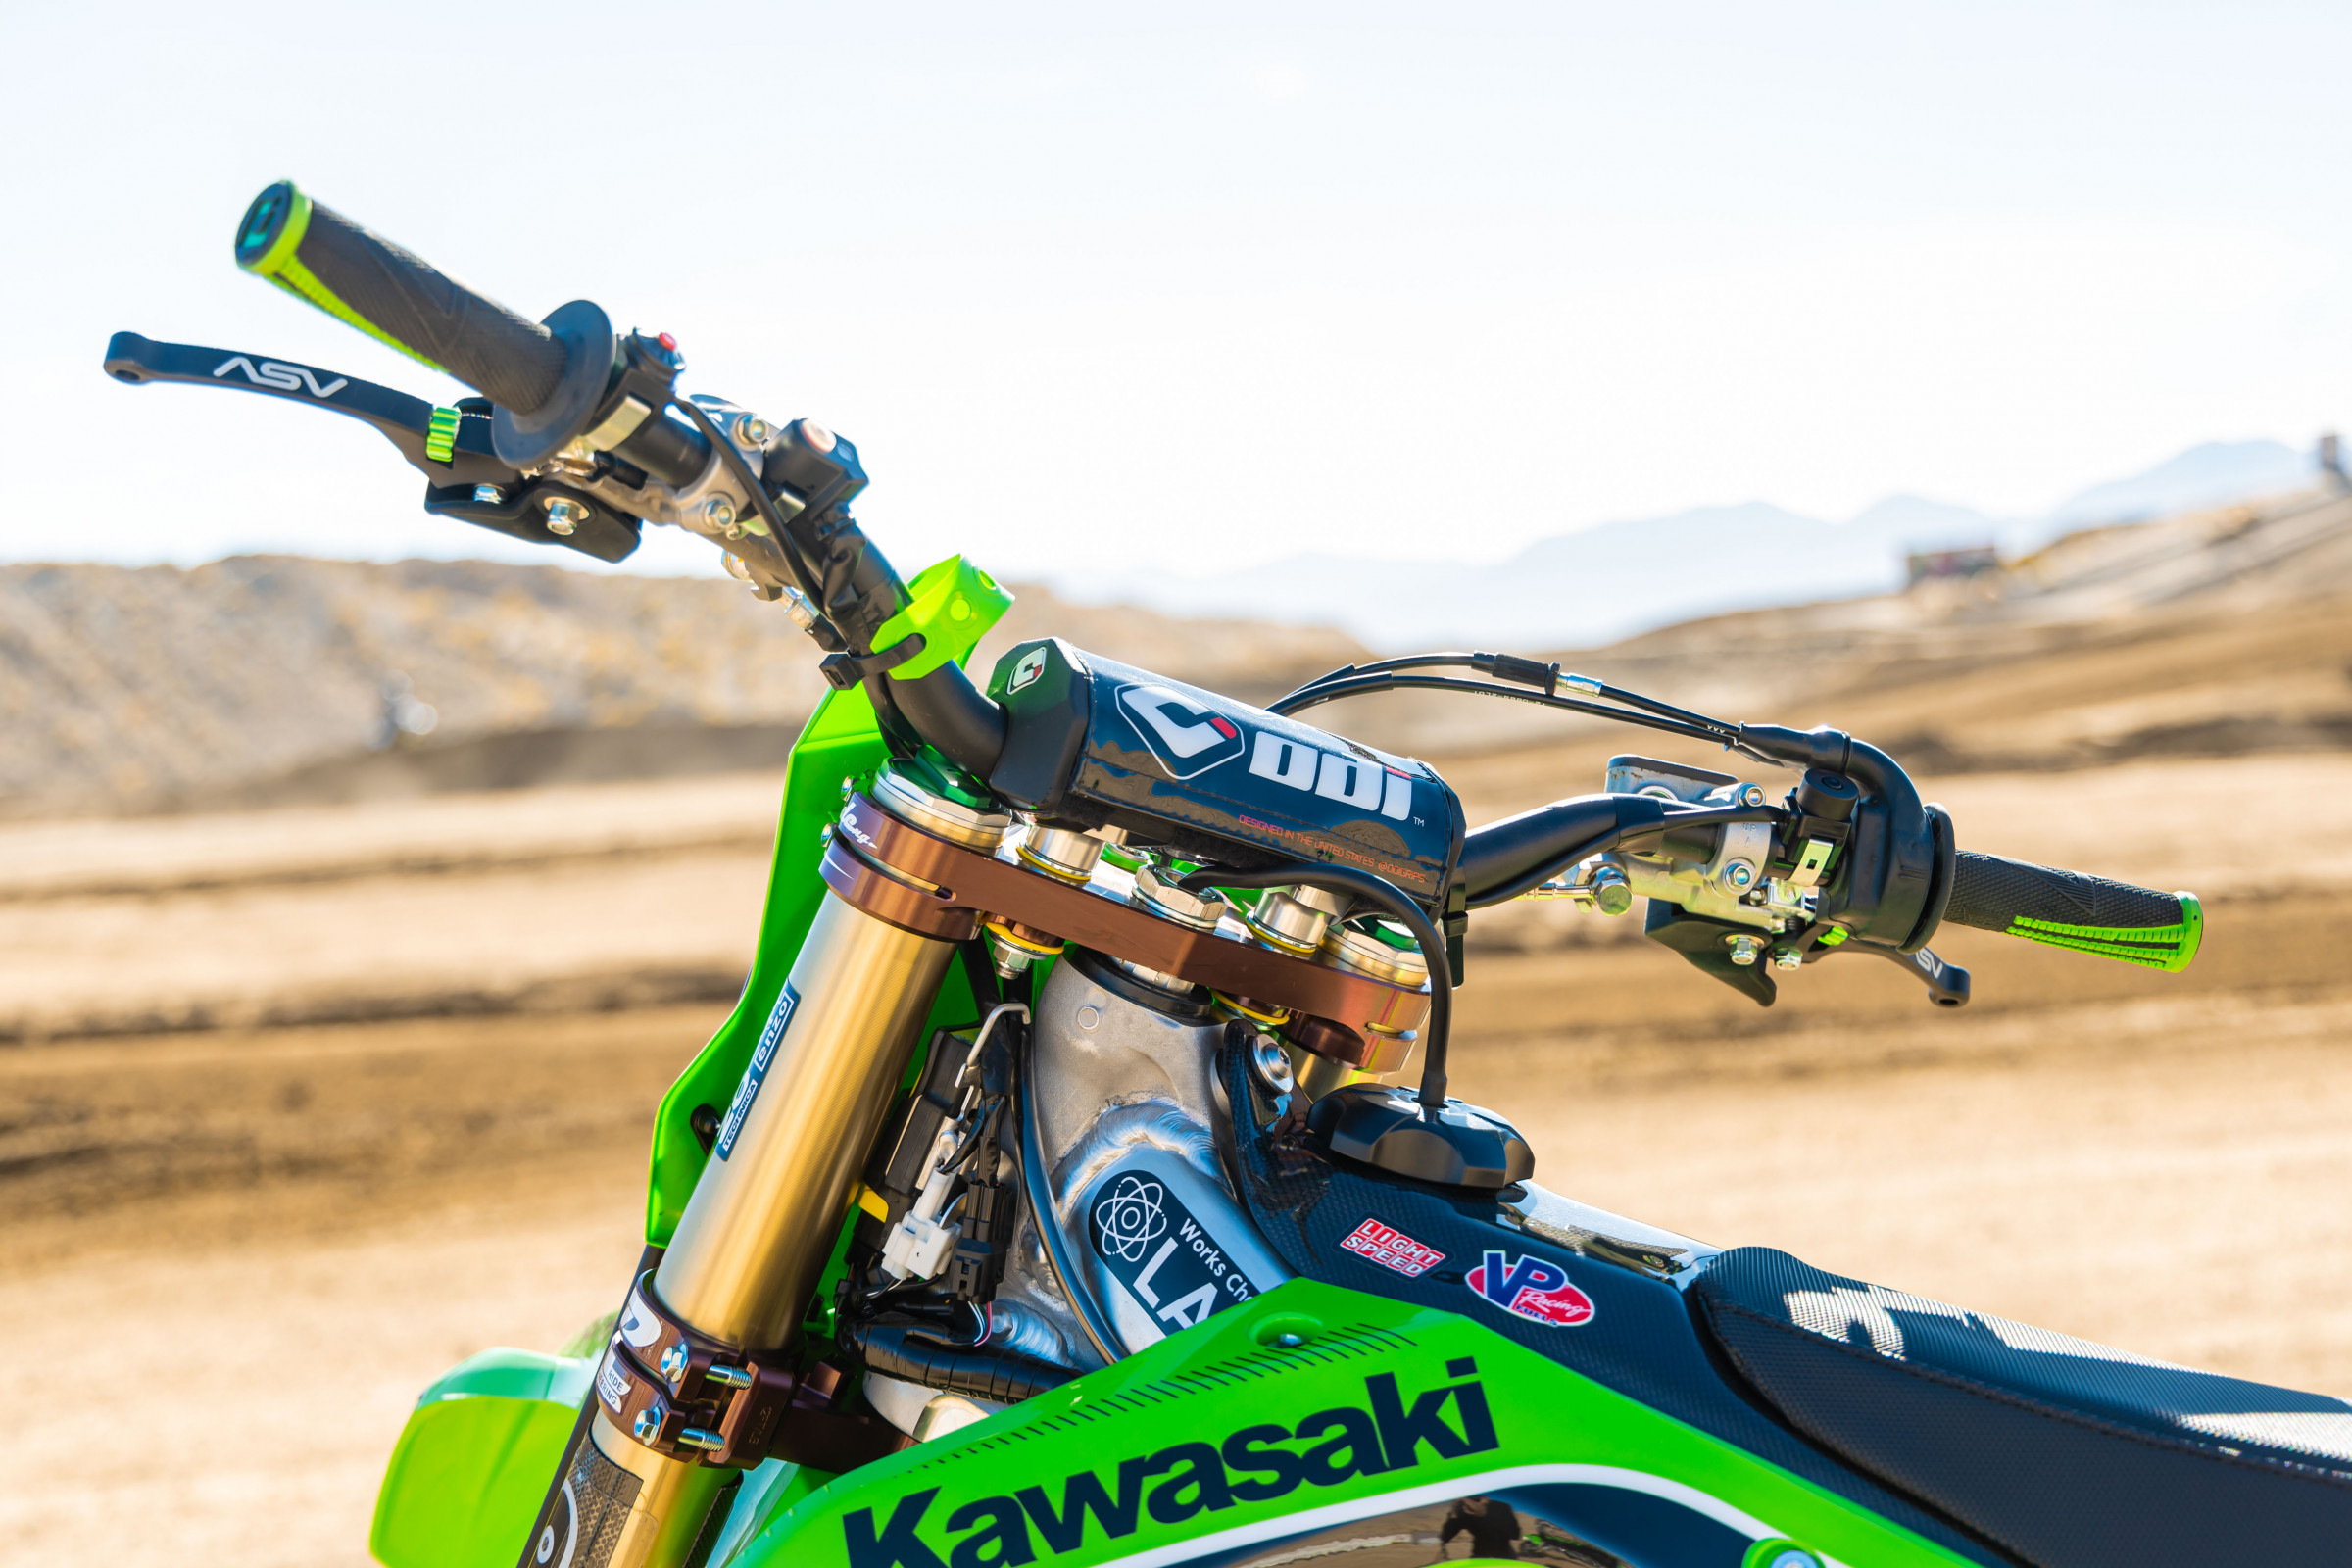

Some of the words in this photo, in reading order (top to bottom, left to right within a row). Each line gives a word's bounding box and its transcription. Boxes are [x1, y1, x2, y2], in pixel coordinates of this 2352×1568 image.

[213, 356, 348, 398] ASV
[1239, 814, 1284, 836] DESIGNED
[1285, 830, 1294, 840] IN
[1297, 833, 1313, 846] THE
[1314, 838, 1344, 857] UNITED
[1345, 851, 1375, 867] STATES
[1915, 947, 1943, 979] SV
[759, 1001, 788, 1062] enzo
[1179, 1217, 1226, 1276] Works
[1345, 1236, 1424, 1274] SPEED
[1360, 1222, 1441, 1263] LIGHT
[1483, 1250, 1568, 1308] VP
[1515, 1304, 1558, 1327] FUELS
[1518, 1290, 1589, 1317] Racing
[608, 1369, 623, 1392] RIDE
[842, 1357, 1500, 1568] Kawasaki
